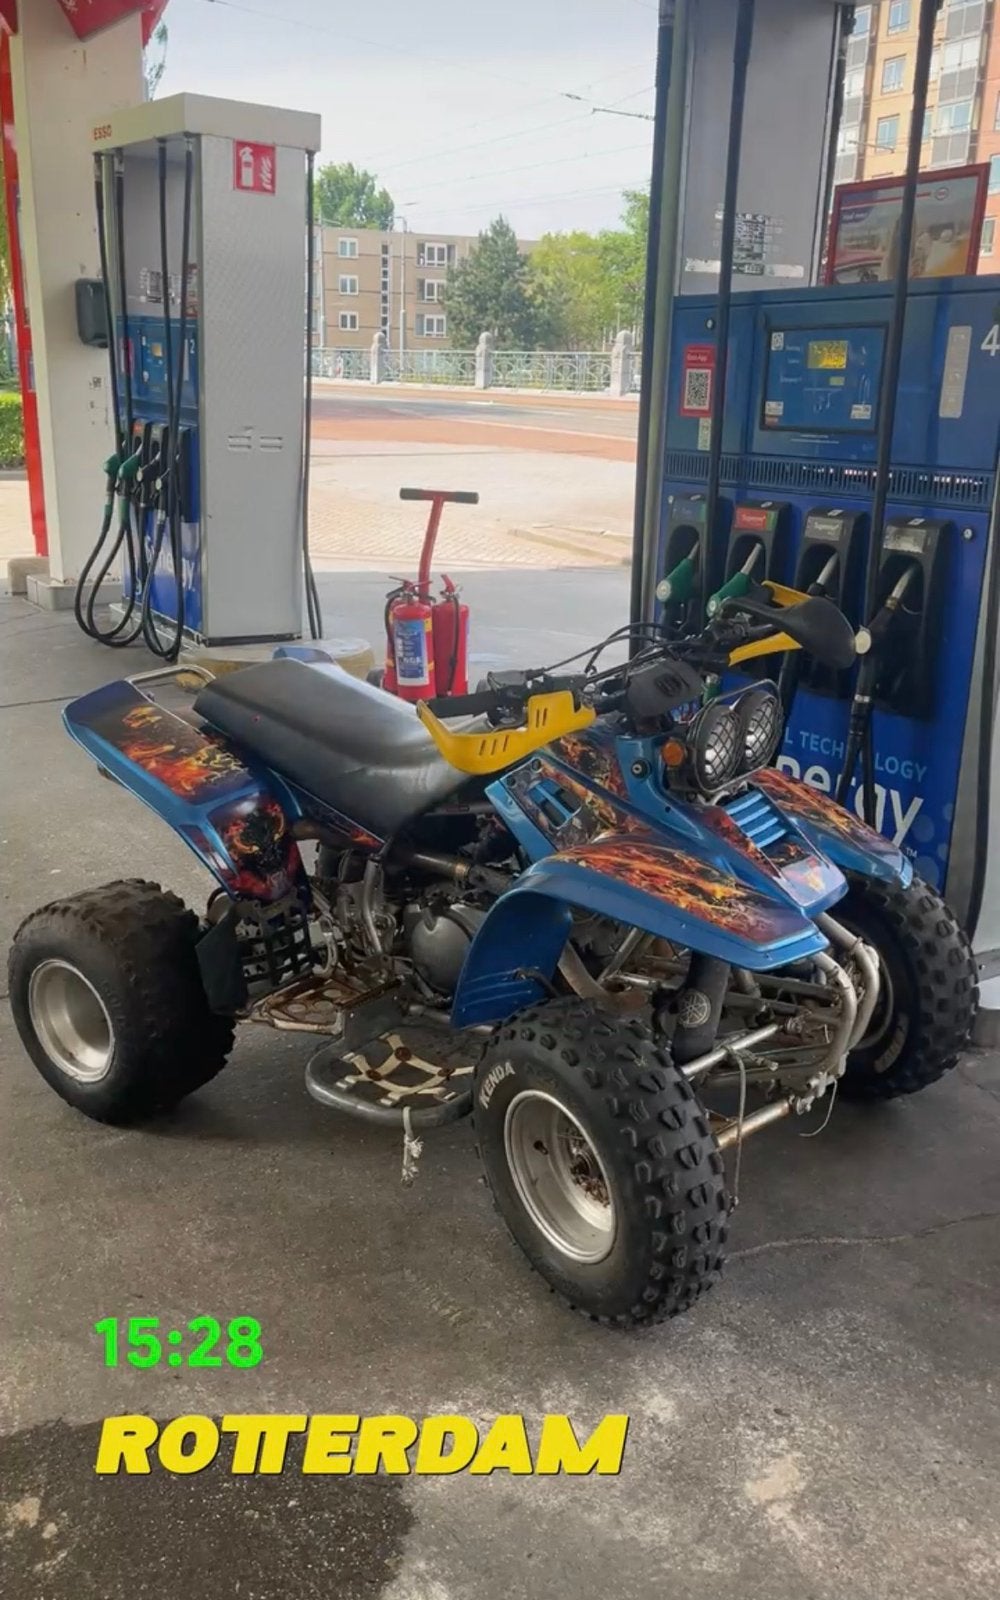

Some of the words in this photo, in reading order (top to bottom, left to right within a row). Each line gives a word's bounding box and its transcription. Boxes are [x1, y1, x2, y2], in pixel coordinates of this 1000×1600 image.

[189, 338, 196, 354] 2
[980, 324, 1000, 357] 4
[800, 731, 927, 783] TECHLOGY
[479, 1061, 516, 1110] KENDA
